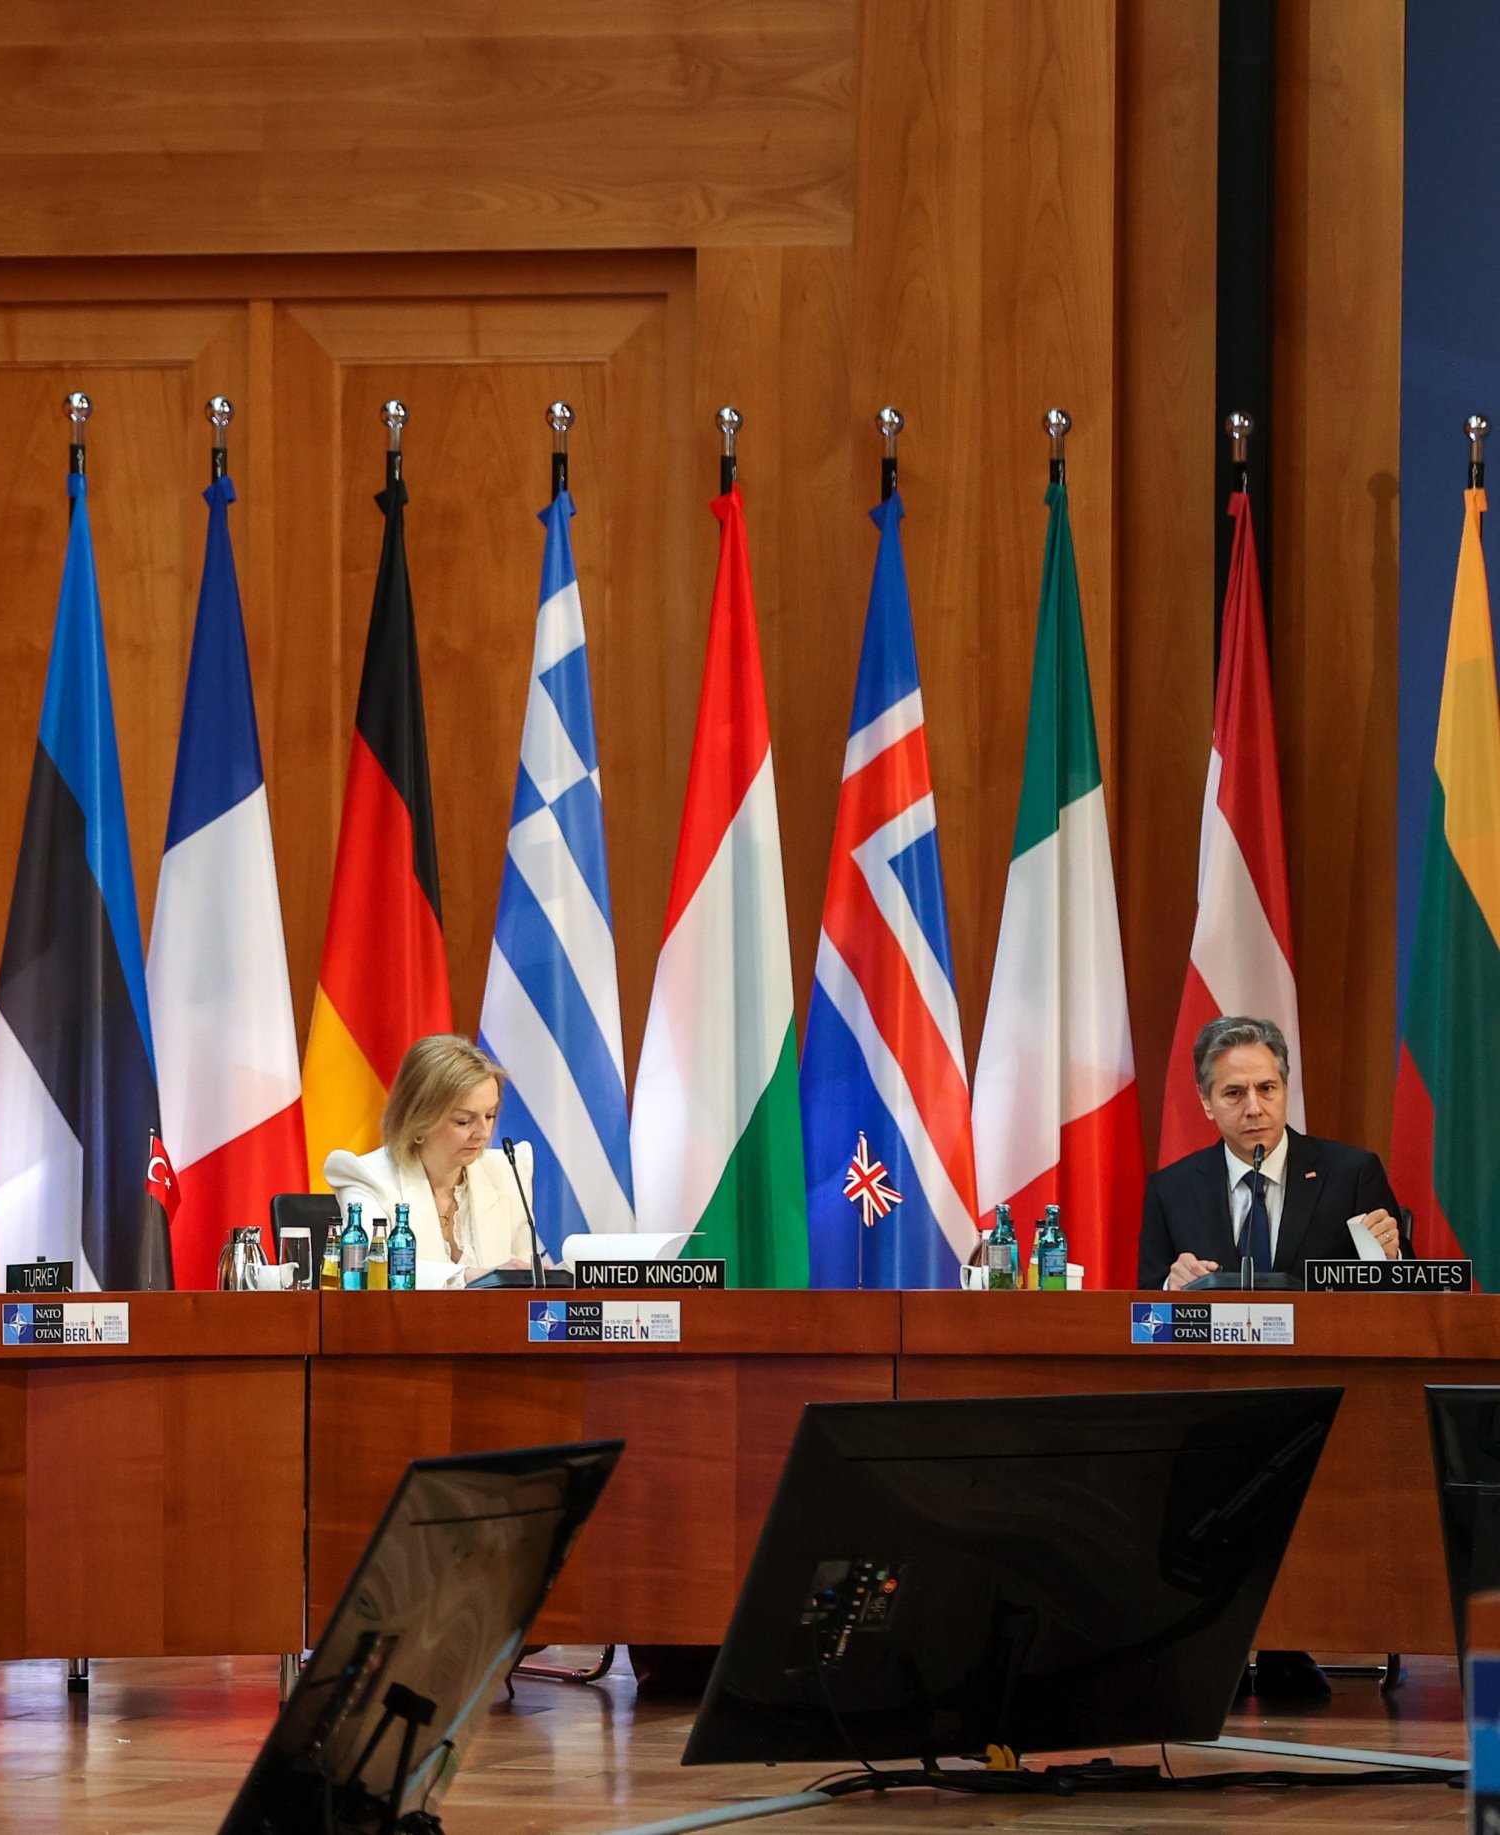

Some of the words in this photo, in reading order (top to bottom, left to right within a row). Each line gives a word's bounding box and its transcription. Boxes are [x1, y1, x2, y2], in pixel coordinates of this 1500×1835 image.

[23, 1267, 59, 1287] TURKEY
[582, 1265, 639, 1284] UNITED
[646, 1265, 717, 1284] KINGDOM
[1314, 1266, 1382, 1284] UNITED
[1391, 1265, 1463, 1284] STATES
[35, 1309, 61, 1319] NATO
[568, 1306, 600, 1317] NATO
[1174, 1309, 1209, 1319] NATO
[35, 1328, 61, 1338] OTAN
[65, 1328, 103, 1342] BERLIN
[568, 1326, 600, 1336] OTAN
[604, 1325, 649, 1339] BERLIN
[1174, 1328, 1209, 1338] OTAN
[1213, 1328, 1261, 1342] BERLIN
